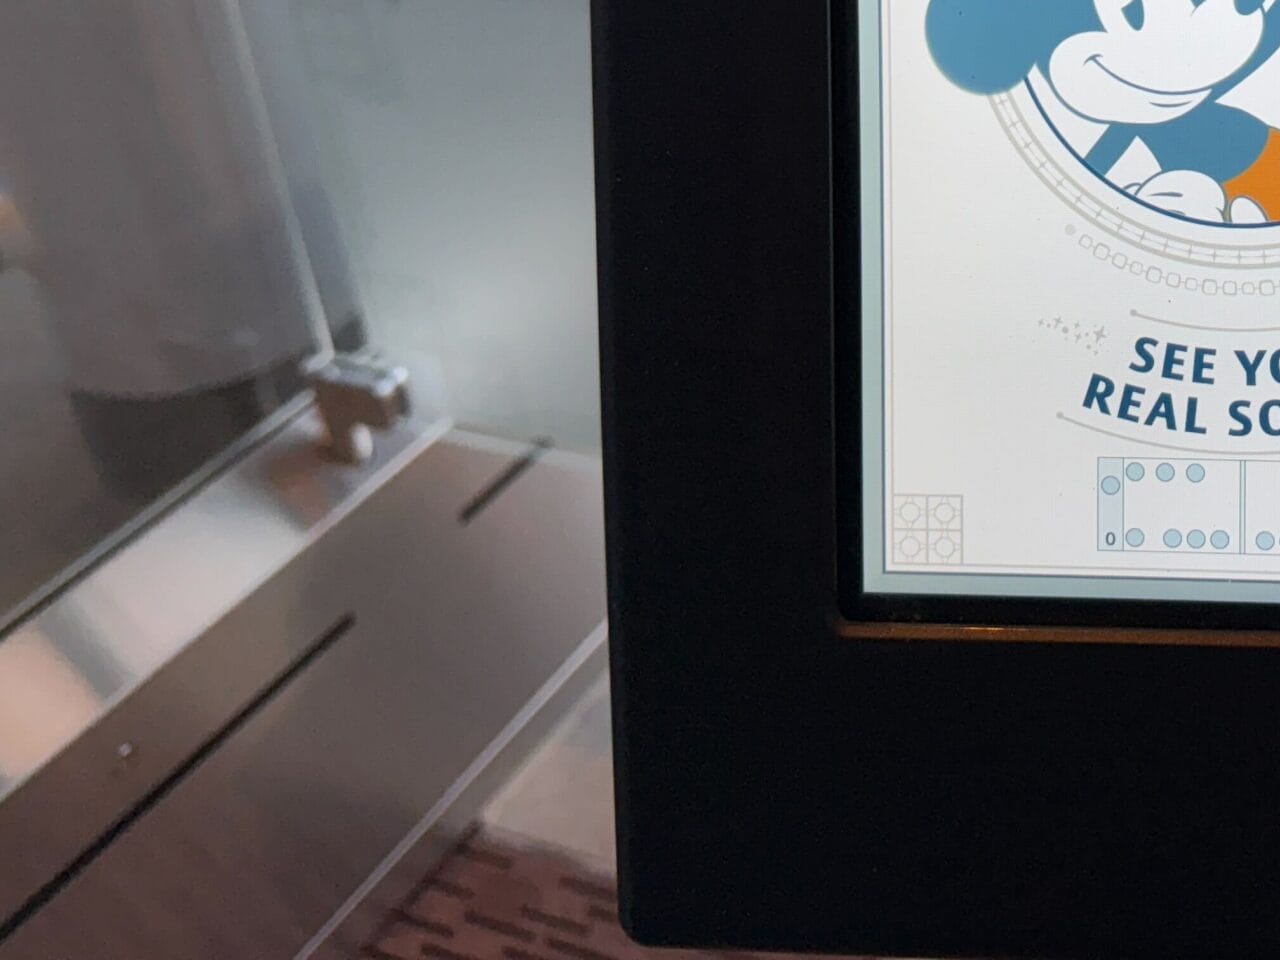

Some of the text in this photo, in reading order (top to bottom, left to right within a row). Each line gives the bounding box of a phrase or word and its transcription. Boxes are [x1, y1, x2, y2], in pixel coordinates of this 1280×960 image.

[1129, 336, 1217, 385] SEE
[1082, 373, 1207, 436] REAL
[1105, 531, 1117, 546] 0
